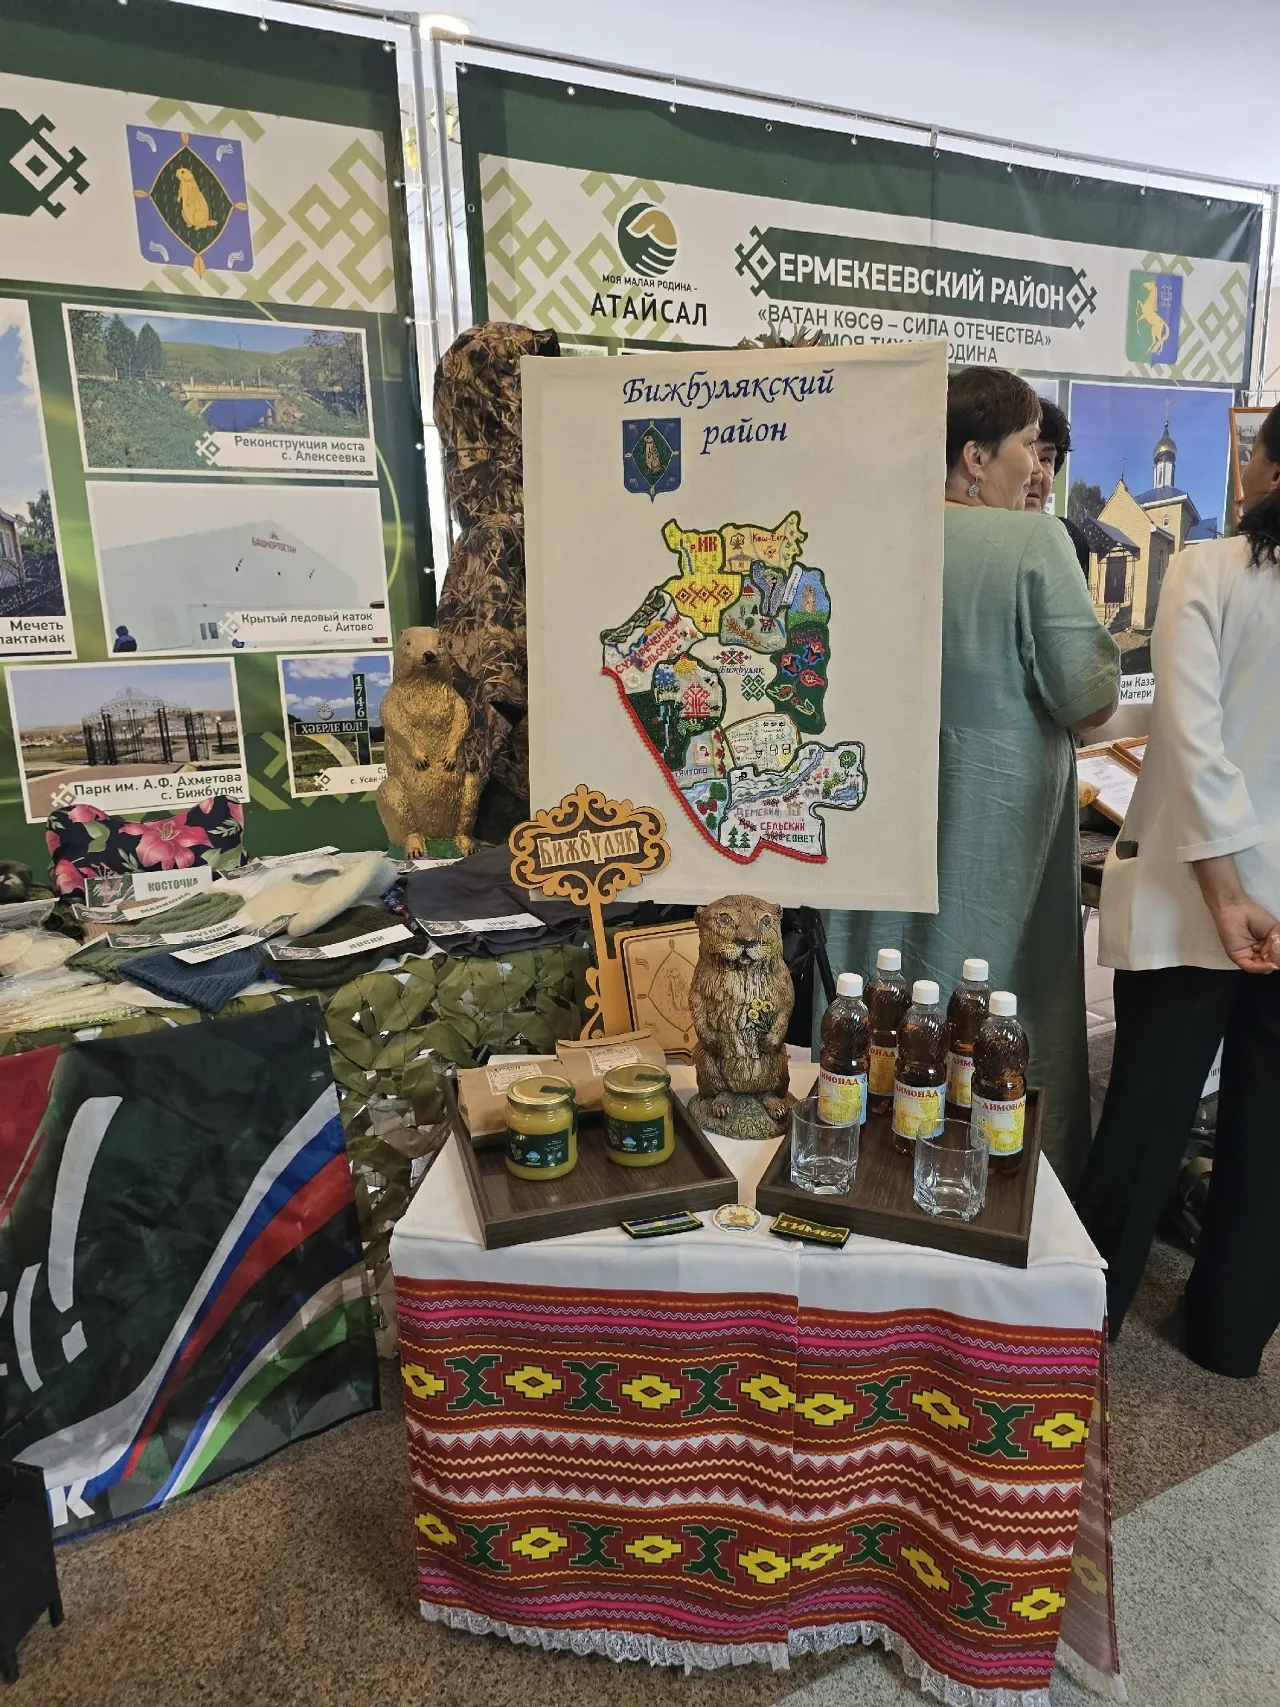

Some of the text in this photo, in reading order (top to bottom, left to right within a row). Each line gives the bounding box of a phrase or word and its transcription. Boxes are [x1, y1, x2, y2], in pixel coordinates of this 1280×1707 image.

[602, 274, 622, 284] МОЯ
[624, 277, 655, 288] МАЛАЯ
[657, 280, 692, 292] РОДИНА
[779, 252, 1064, 311] ЕРМЕКЕЕВСКИЙ РАЙОН
[590, 292, 707, 326] АТАЙСАЛ
[758, 304, 828, 327] «ВАТАН
[903, 316, 949, 336] СИЛА
[953, 321, 1052, 346] ОТЕЧЕСТВА»
[948, 344, 998, 363] ОДИНА
[622, 368, 834, 409] Бижбулякский
[234, 435, 365, 452] Реконструкция моста
[700, 417, 787, 455] район
[281, 451, 365, 463] с. Алексеевка
[10, 620, 64, 631] Мечеть
[242, 612, 373, 625] Крытый ледовый каток
[323, 623, 374, 632] с. Аитово
[1121, 677, 1155, 688] ам Каза
[354, 675, 365, 718] 1746
[1120, 690, 1152, 700] Матери
[74, 773, 242, 798] Парк им. А.Ф. Ахметова
[161, 785, 243, 800] с. Бижбуляк
[148, 878, 199, 893] КОСТОЧКА
[870, 1048, 895, 1058] ОНАД
[952, 1057, 975, 1068] ЛИМО
[820, 1070, 859, 1086] ИМОНАД
[982, 1101, 1025, 1112] ЛИМОНА
